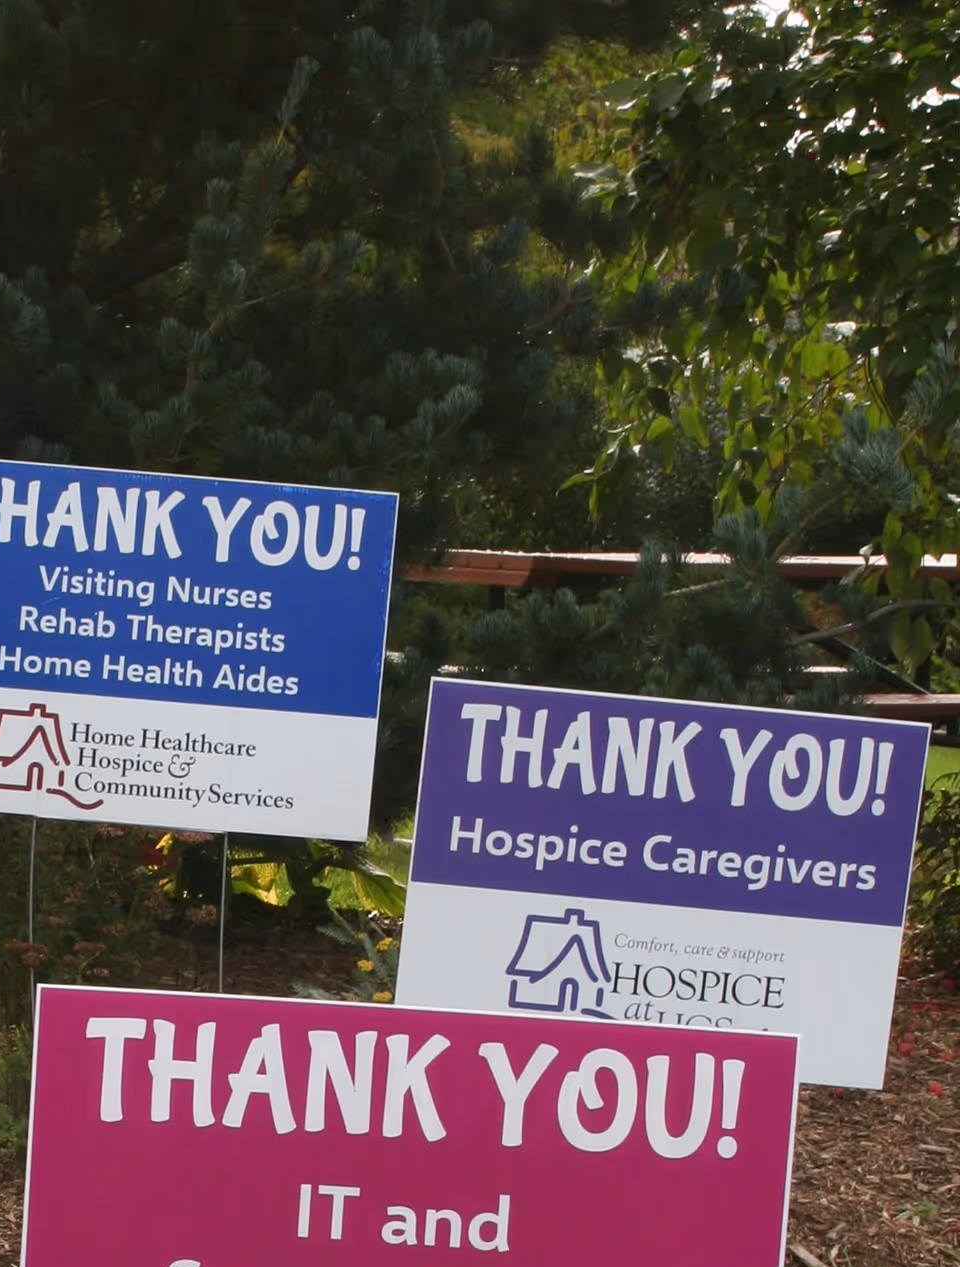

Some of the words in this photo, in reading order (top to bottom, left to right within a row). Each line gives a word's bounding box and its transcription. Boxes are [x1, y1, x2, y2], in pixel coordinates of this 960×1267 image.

[202, 496, 365, 570] YOU!
[40, 566, 154, 606] Visiting
[167, 576, 271, 609] Nurses
[20, 606, 115, 638] Rehab
[127, 615, 284, 654] Therapists
[0, 646, 90, 677] Home
[103, 655, 202, 687] Health
[213, 665, 298, 695] Aides
[71, 723, 134, 747] Home
[140, 729, 256, 757] Healthcare
[77, 747, 163, 777] Hospice
[168, 754, 196, 778] &
[461, 703, 702, 802] THANK
[720, 728, 894, 816] YOU!
[75, 772, 205, 802] Community
[208, 784, 293, 809] Services
[450, 816, 627, 870] Hospice
[643, 835, 876, 890] Caregivers
[615, 933, 677, 954] Comfort,
[684, 945, 713, 956] care
[732, 949, 784, 963] support
[611, 962, 785, 1008] HOSPICE
[624, 1001, 653, 1021] at
[86, 1018, 450, 1141] THANK
[479, 1043, 745, 1158] YOU!
[298, 1184, 360, 1239] IT
[382, 1195, 510, 1252] and
